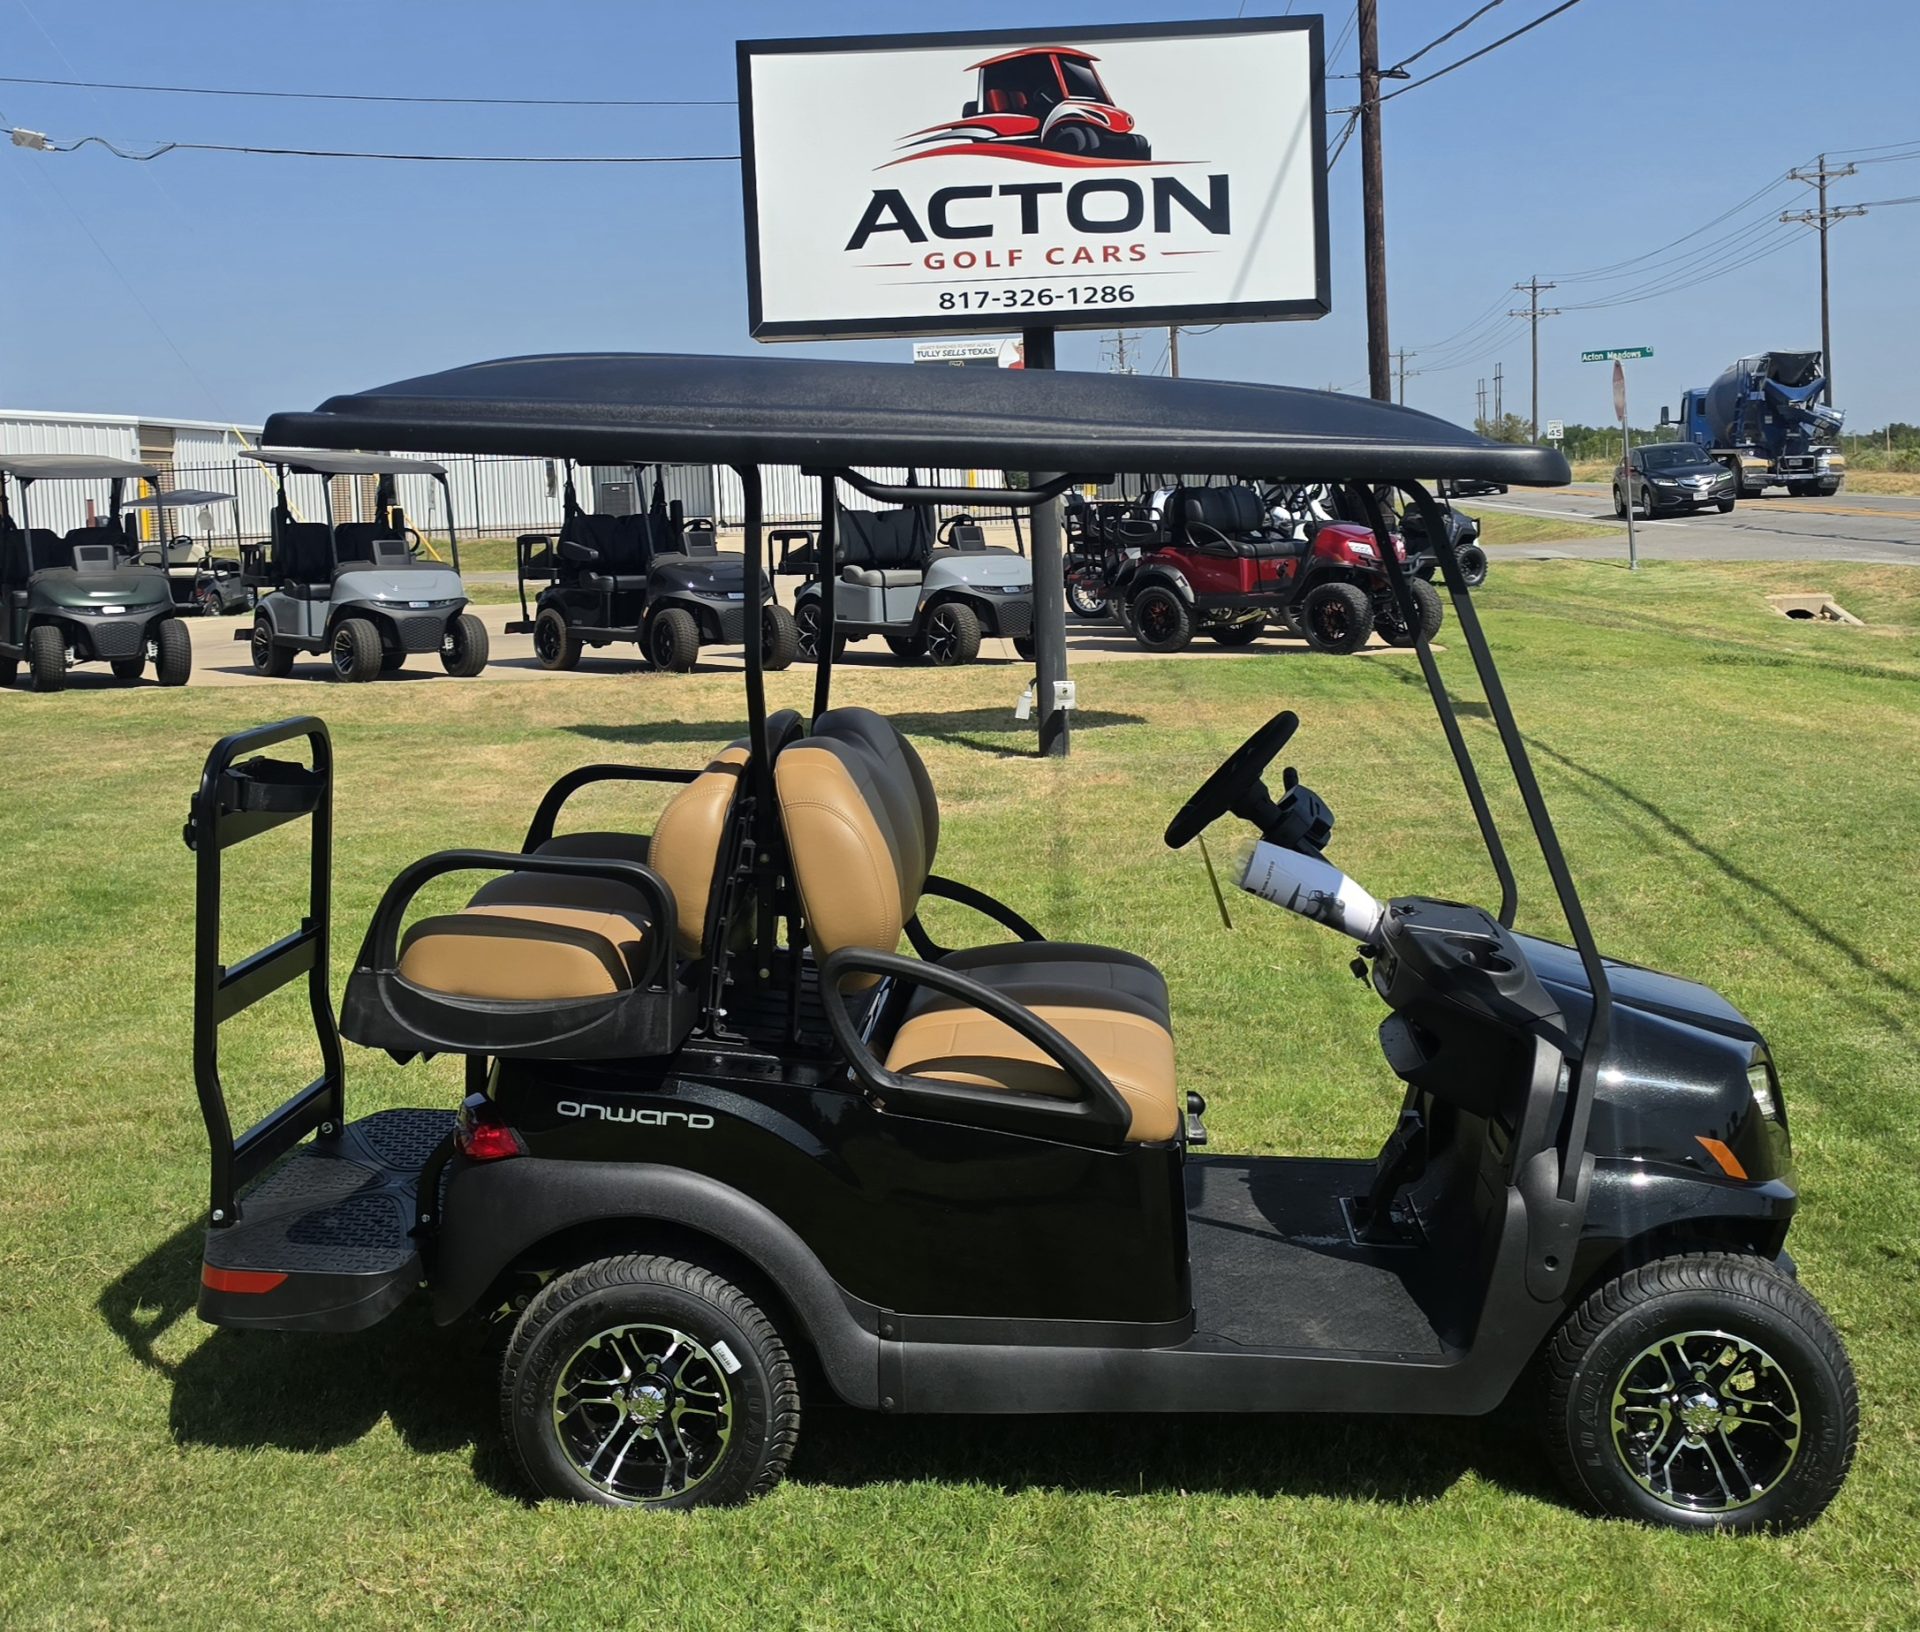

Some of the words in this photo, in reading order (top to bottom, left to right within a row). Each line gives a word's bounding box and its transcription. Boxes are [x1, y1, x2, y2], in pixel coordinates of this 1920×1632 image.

[844, 174, 1231, 252] ACTON
[924, 249, 1022, 270] GOLF
[1045, 244, 1147, 265] CARS
[938, 285, 1135, 310] 817-326-1286
[917, 350, 940, 358] TULLY
[942, 348, 966, 357] SELLS
[1582, 353, 1604, 361] Acton
[1607, 350, 1642, 360] Meadows
[1549, 429, 1562, 437] 45
